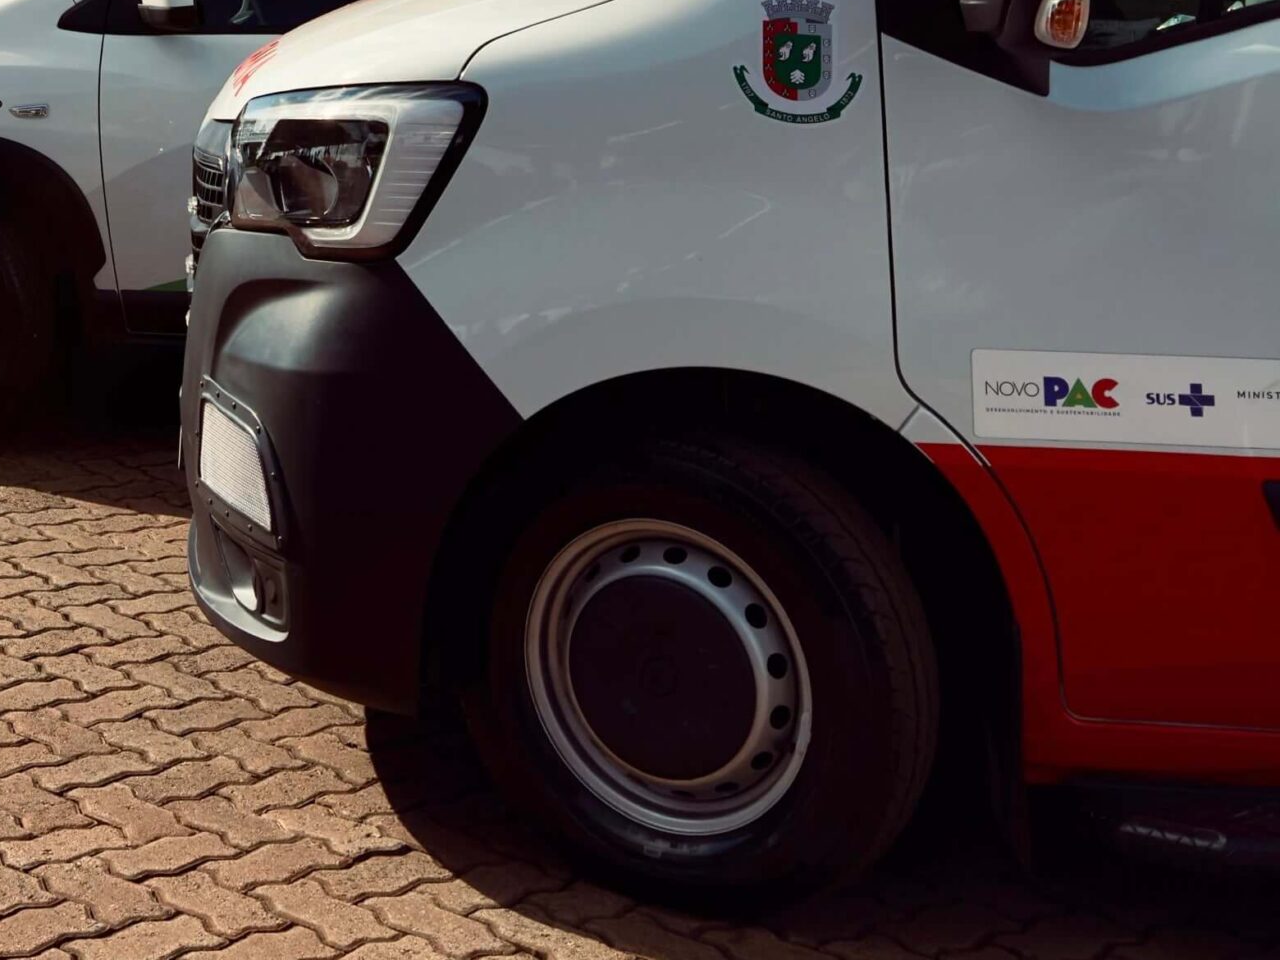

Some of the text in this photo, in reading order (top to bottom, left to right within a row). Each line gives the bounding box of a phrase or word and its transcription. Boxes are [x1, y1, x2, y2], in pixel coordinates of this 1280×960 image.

[766, 108, 794, 121] SANTO
[985, 376, 1120, 409] NOVO PAC
[1145, 393, 1176, 405] SUS
